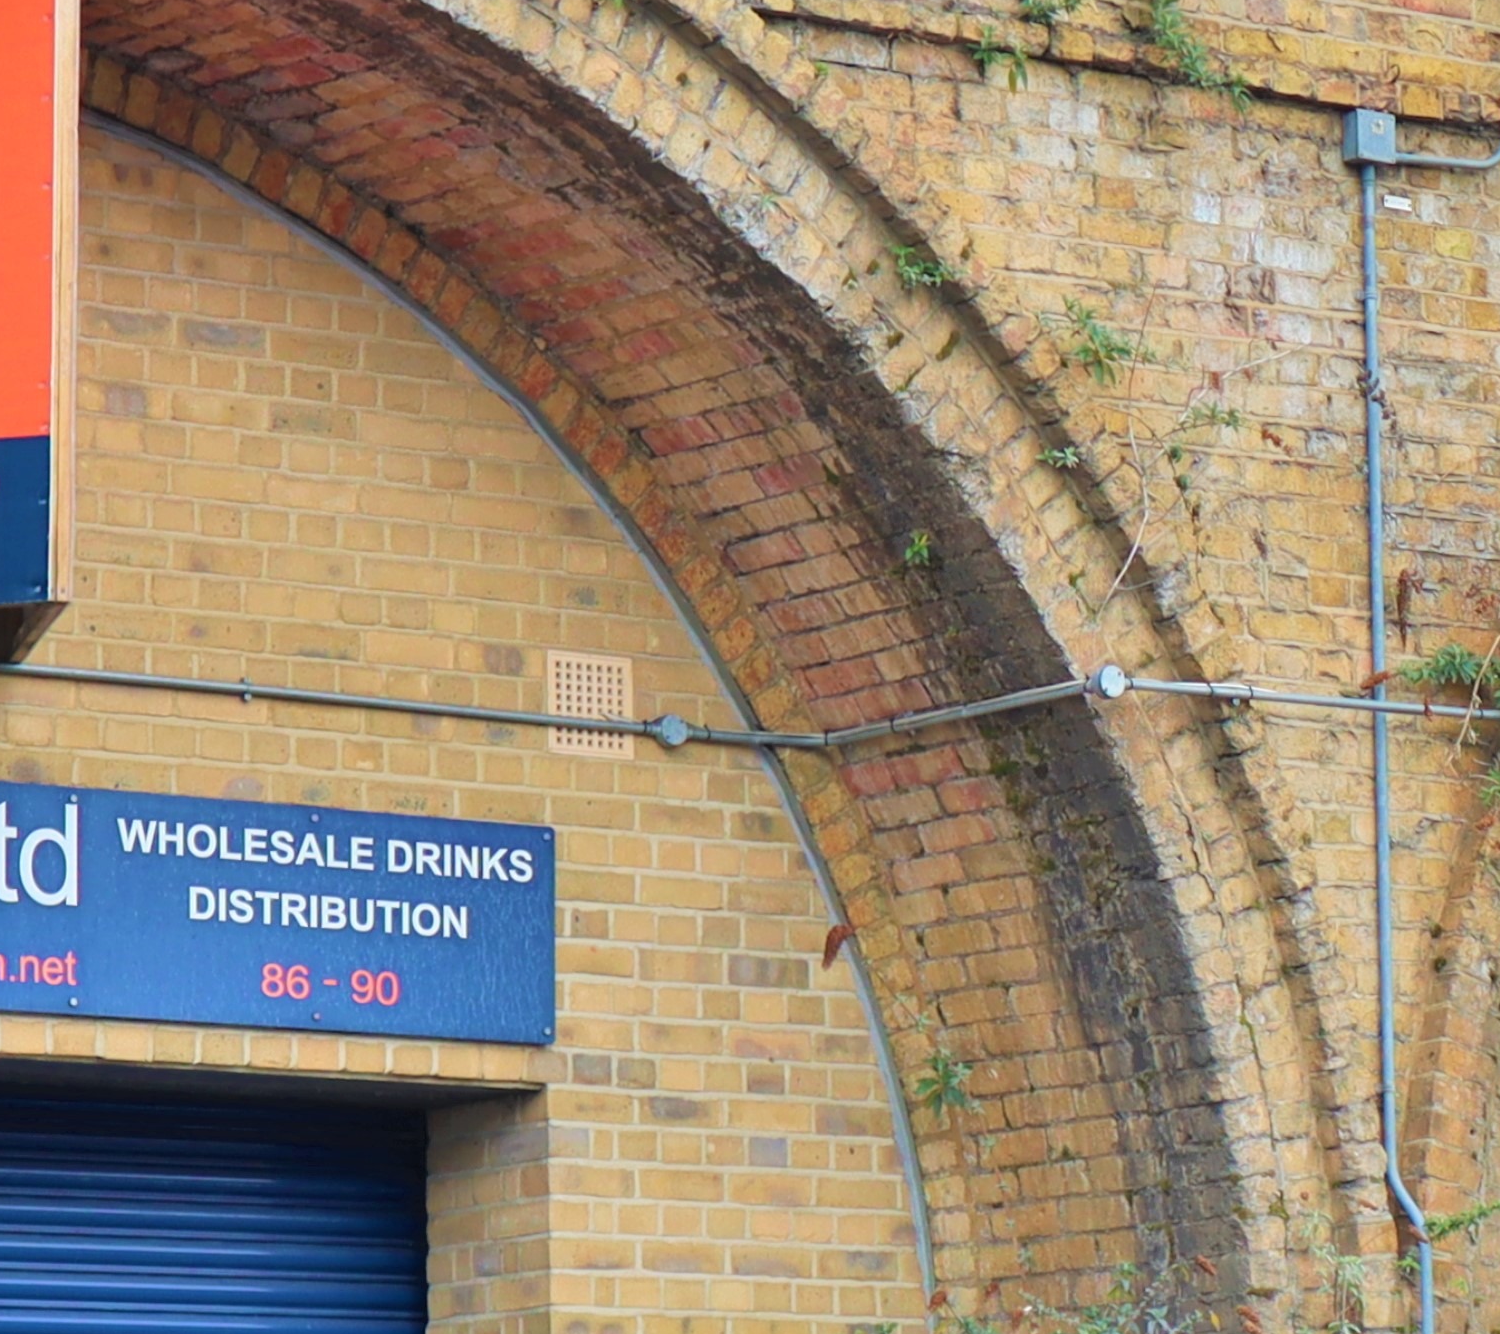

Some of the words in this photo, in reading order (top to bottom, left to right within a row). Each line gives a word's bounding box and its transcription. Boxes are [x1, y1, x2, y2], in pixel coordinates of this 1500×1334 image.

[117, 817, 375, 873] WHOLESALE
[387, 839, 534, 884] DRINKS
[187, 885, 469, 939] DISTRIBUTION
[260, 962, 310, 1001] 86
[350, 969, 400, 1008] 90
